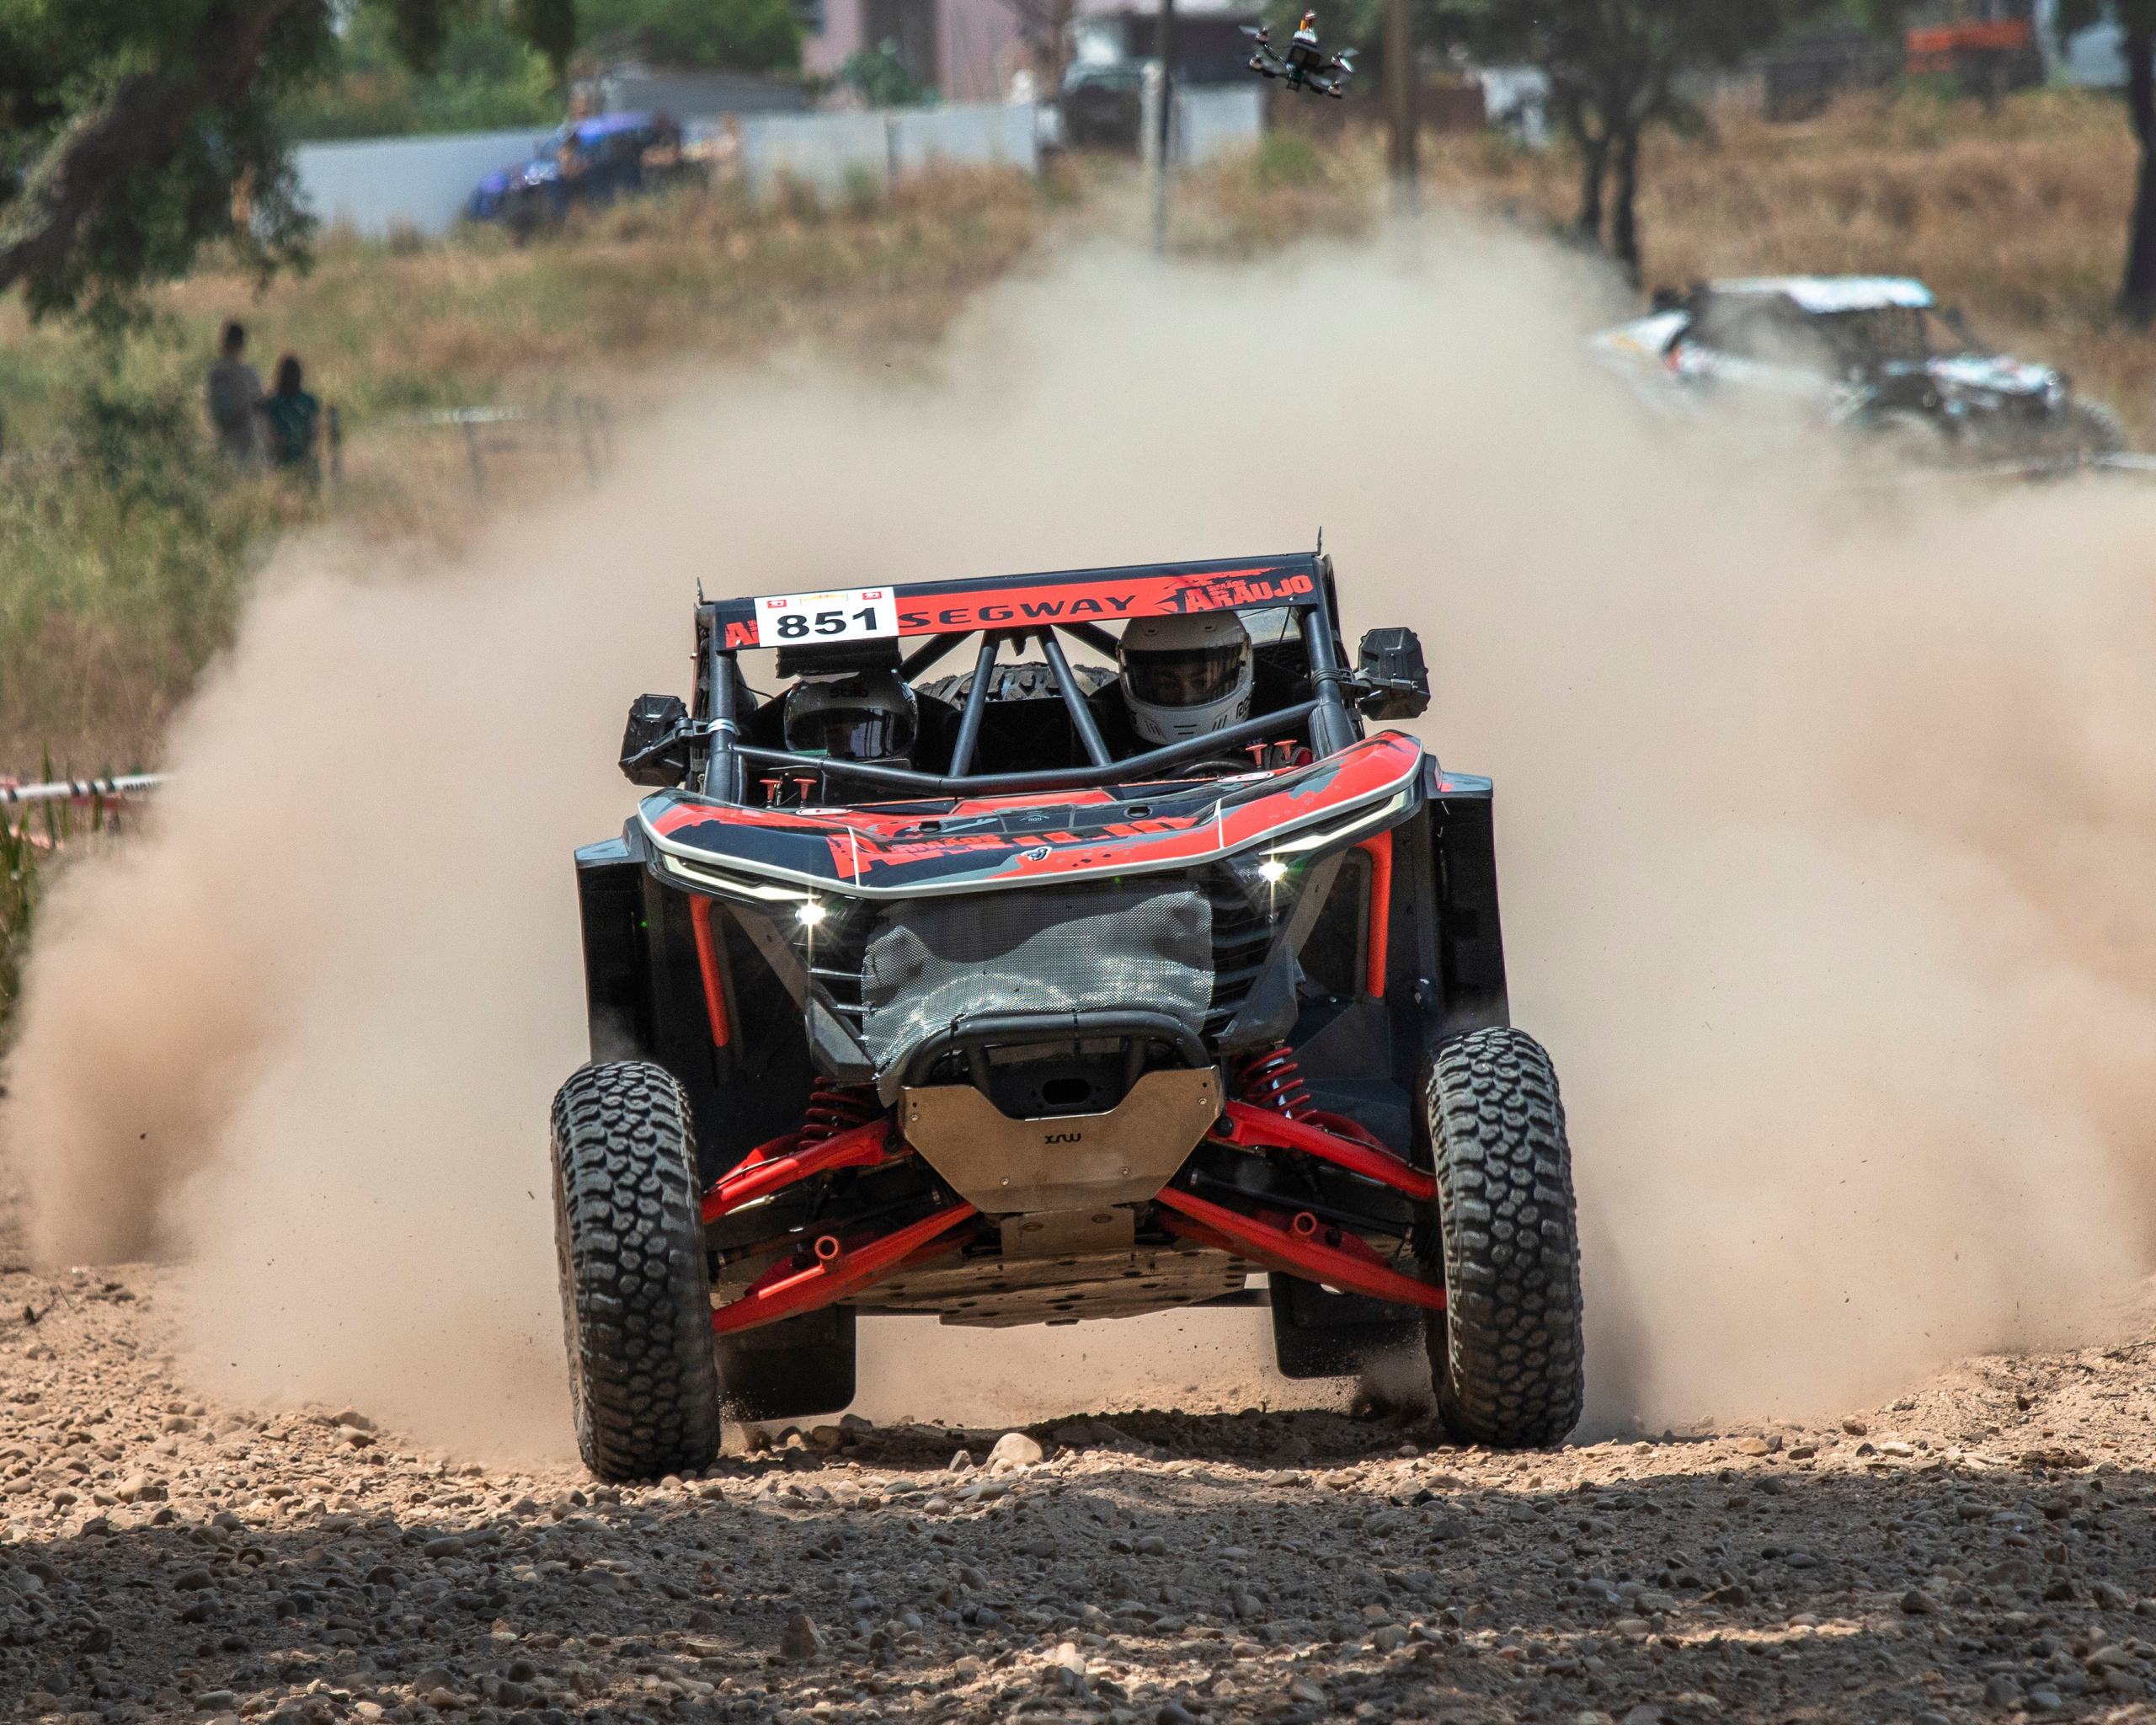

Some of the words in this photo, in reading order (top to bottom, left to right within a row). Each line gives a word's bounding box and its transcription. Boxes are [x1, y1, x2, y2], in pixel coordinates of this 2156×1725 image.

[1185, 574, 1314, 613] ARAUJO
[776, 607, 878, 638] 851
[898, 595, 1137, 628] SEGWAY
